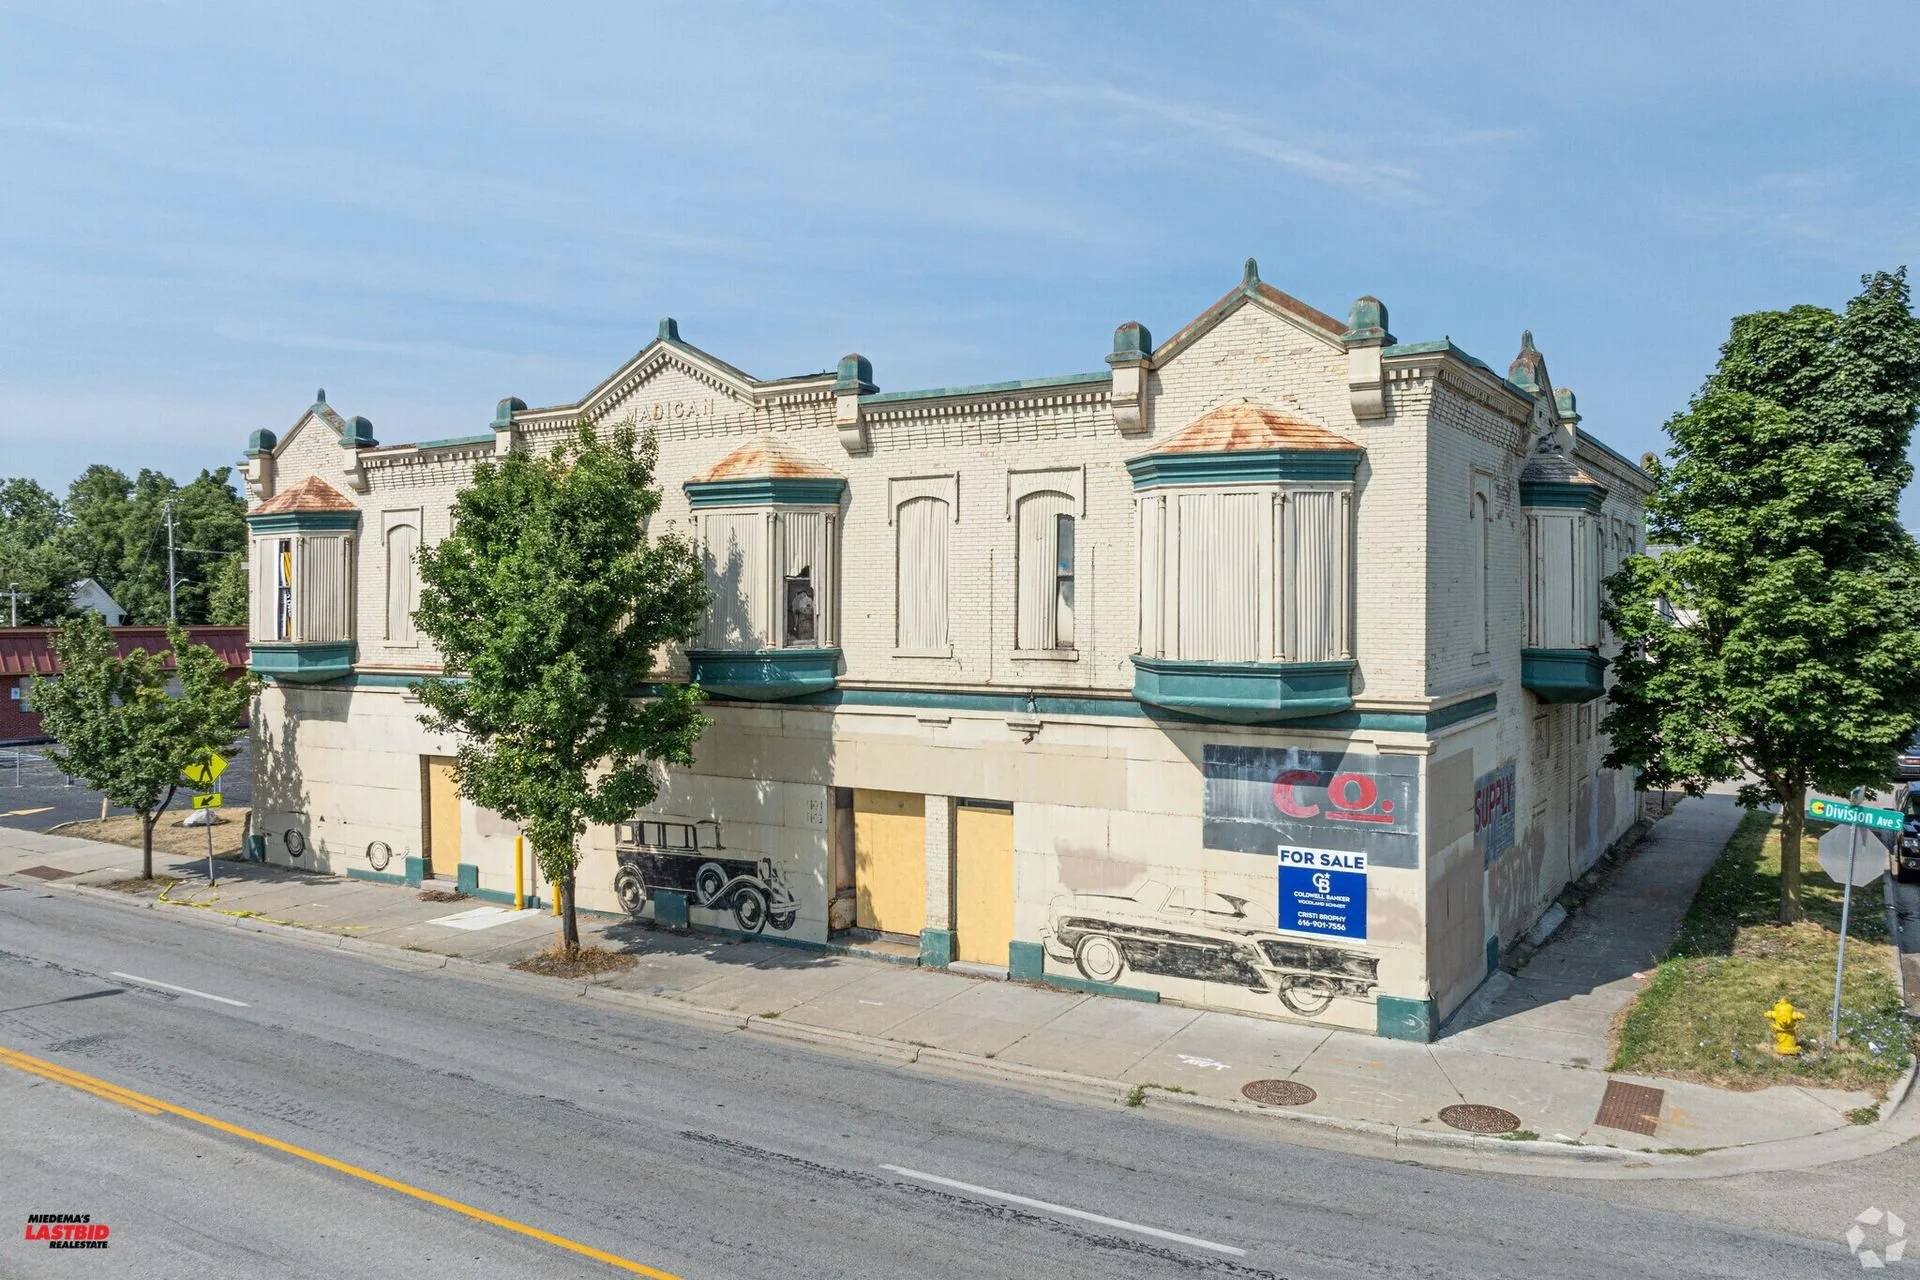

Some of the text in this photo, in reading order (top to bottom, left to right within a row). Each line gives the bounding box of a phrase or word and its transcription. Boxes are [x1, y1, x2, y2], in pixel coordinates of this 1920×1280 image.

[1474, 773, 1513, 833] SUPPLY
[1825, 804, 1902, 829] Division Ave S
[1280, 850, 1364, 869] FOR SALE
[1293, 891, 1350, 902] COLDWELL BANKER
[1297, 911, 1346, 922] CRISTI BROPHY
[1297, 919, 1346, 931] 616-901-7556
